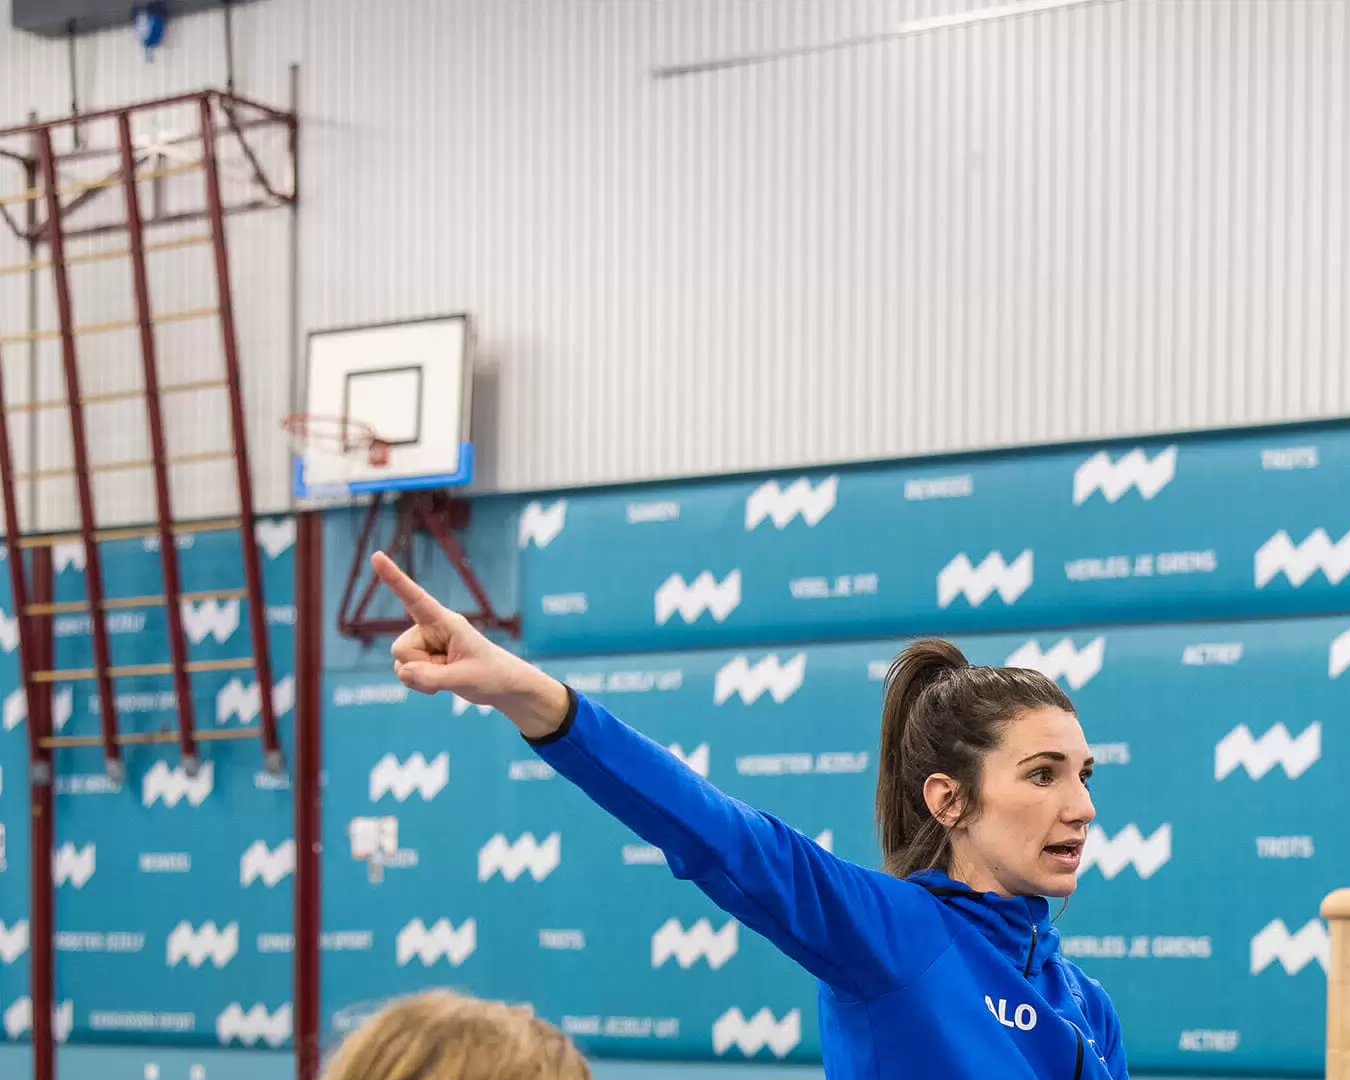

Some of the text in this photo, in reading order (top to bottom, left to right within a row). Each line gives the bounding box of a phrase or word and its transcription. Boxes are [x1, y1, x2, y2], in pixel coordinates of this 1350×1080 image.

[1261, 446, 1319, 470] TROTS
[1133, 554, 1154, 577] JE
[1181, 642, 1244, 666] ACTIEF
